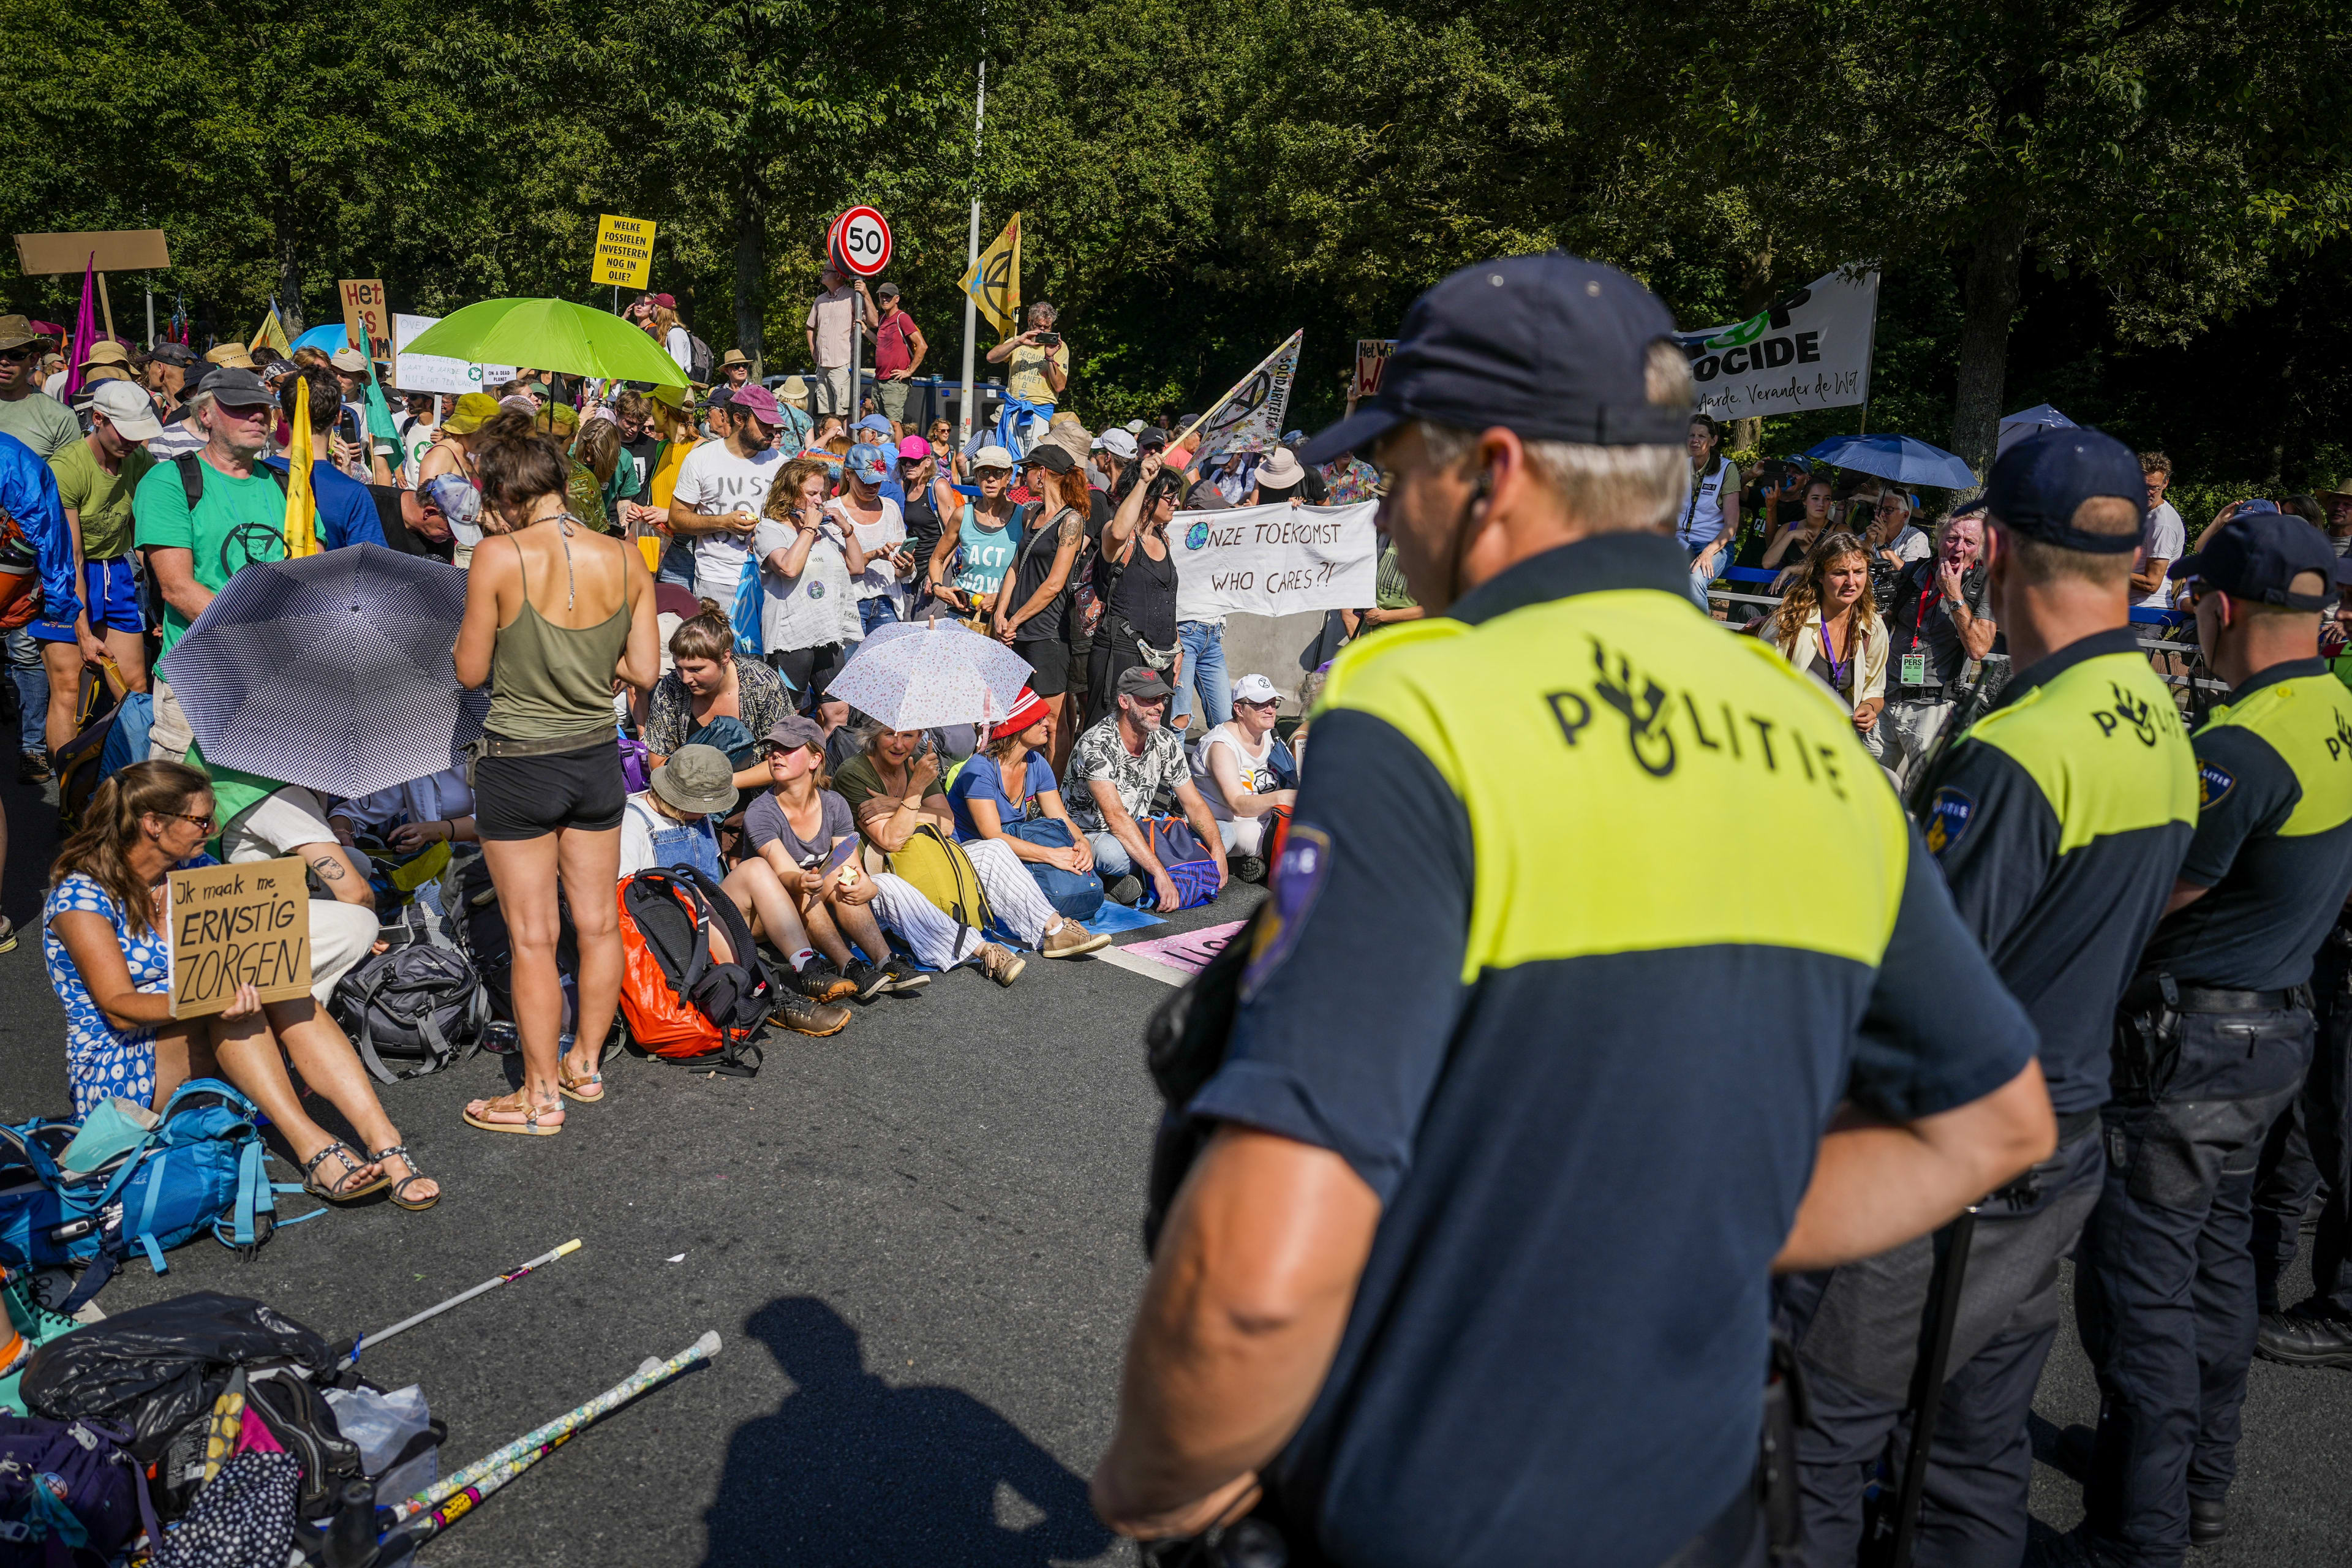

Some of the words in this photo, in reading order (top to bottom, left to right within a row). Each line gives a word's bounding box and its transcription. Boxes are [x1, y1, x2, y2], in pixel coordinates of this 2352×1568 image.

[614, 221, 641, 232] WELKE
[605, 232, 646, 246] FOSSIELEN
[849, 227, 881, 254] 50
[599, 244, 648, 258] INVESTEREN
[607, 257, 624, 268] NOG
[627, 260, 636, 270] IN
[609, 271, 631, 281] OLIE?
[345, 284, 382, 306] Het
[1359, 342, 1376, 358] Het
[1693, 331, 1820, 382] OCIDE
[1014, 372, 1041, 384] PLANET
[1746, 376, 1809, 405] Verander
[1815, 373, 1831, 402] de
[1835, 369, 1858, 395] Wet
[1266, 358, 1291, 423] SOLIDARITEIT
[1254, 522, 1341, 545] TOEKOMST
[968, 545, 1006, 567] ACT
[1212, 571, 1253, 592] WHO
[203, 873, 244, 900] maak
[257, 878, 276, 891] me
[178, 937, 303, 1005] ZORGEN
